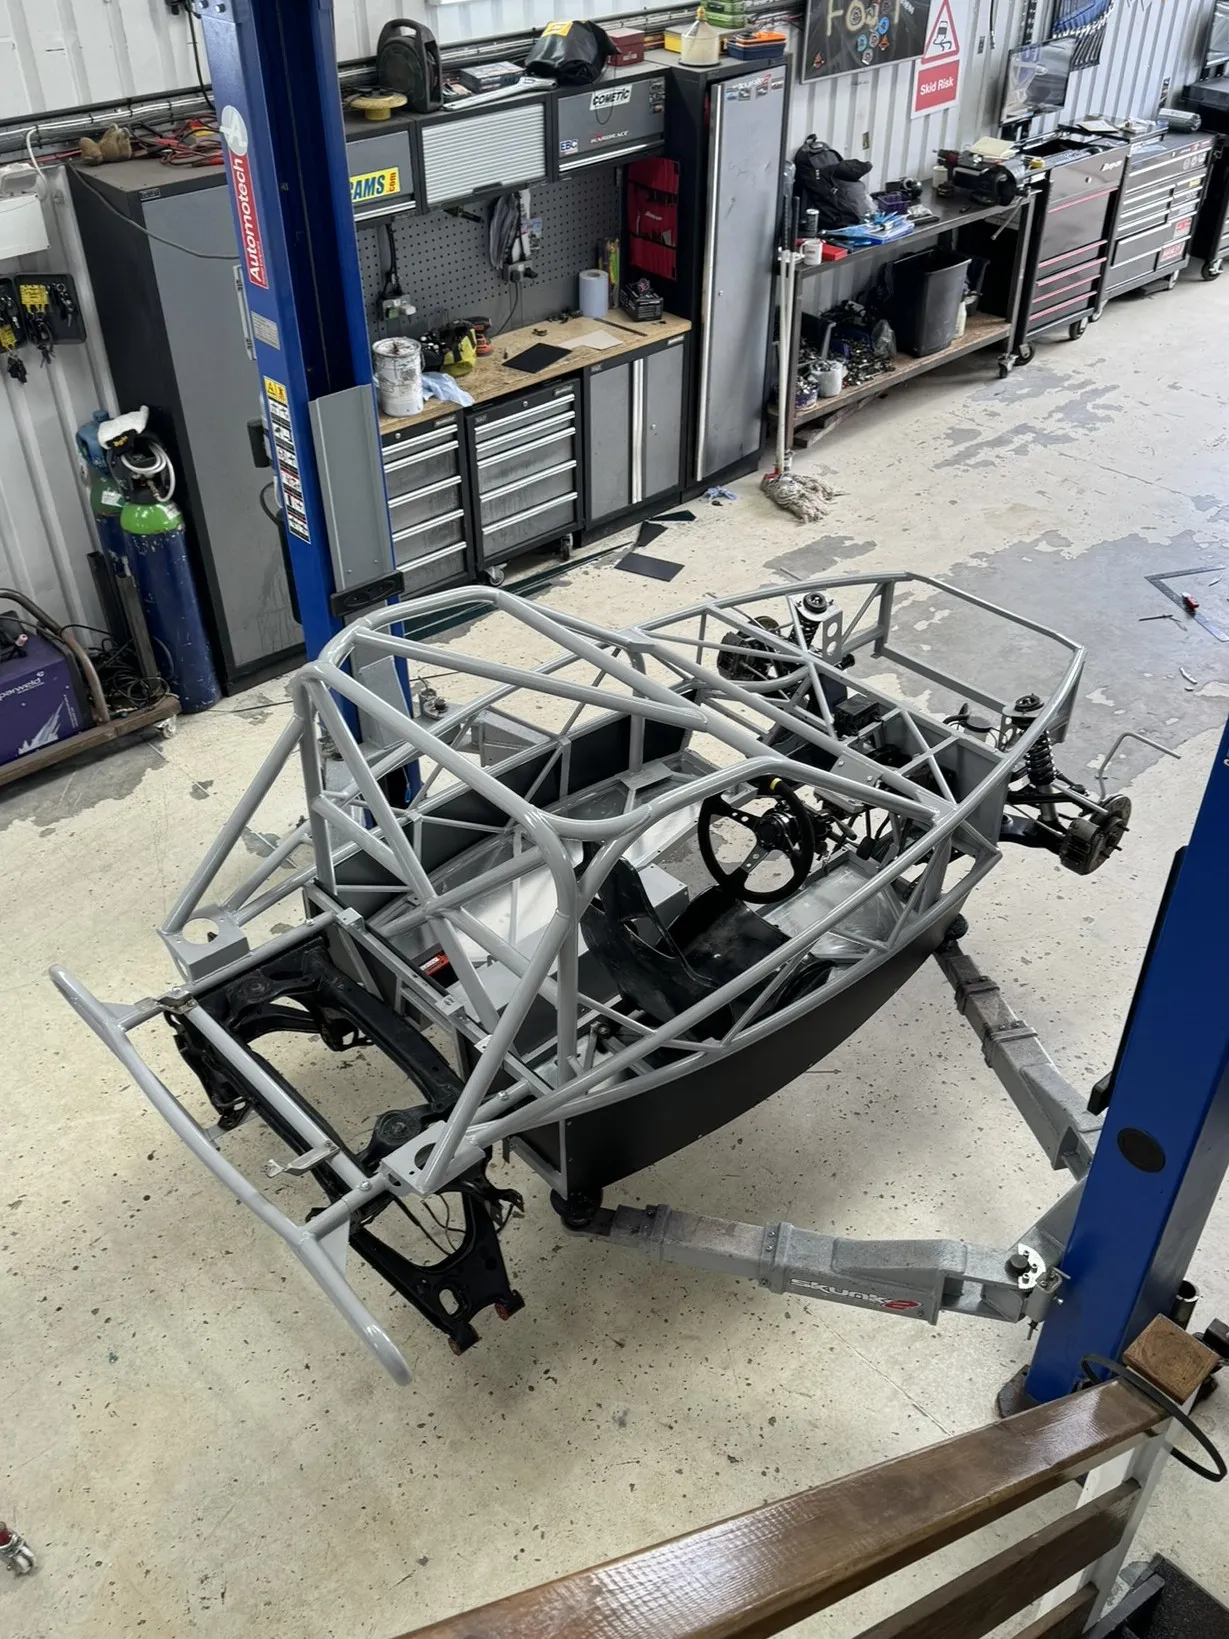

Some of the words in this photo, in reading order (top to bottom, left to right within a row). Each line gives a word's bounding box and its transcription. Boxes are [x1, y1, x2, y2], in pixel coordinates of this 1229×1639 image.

[920, 83, 936, 95] Skid
[938, 77, 954, 91] Risk
[560, 140, 578, 151] EBC
[233, 158, 262, 281] Automotech
